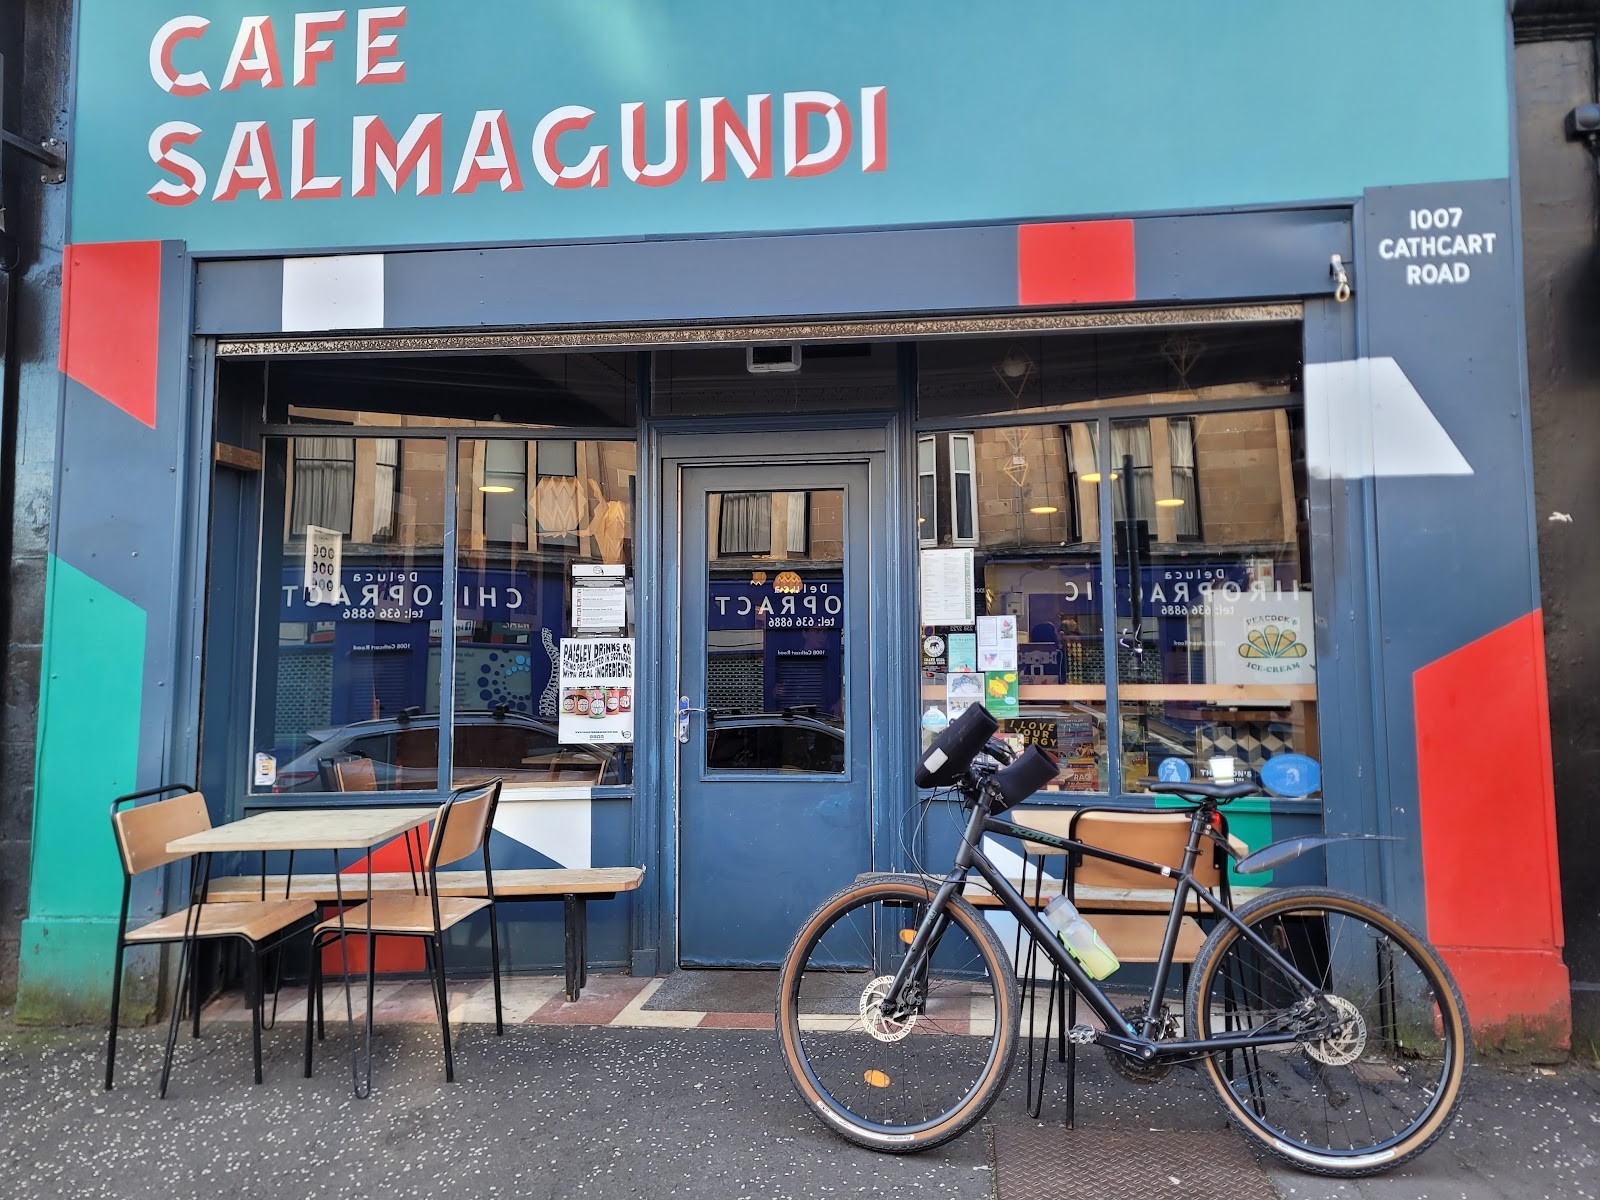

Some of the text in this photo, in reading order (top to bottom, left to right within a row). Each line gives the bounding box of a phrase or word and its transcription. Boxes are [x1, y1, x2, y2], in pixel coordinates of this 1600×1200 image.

[149, 6, 407, 97] CAFE
[146, 86, 888, 207] SALMAGUNDI
[1410, 207, 1463, 230] 1007
[1378, 233, 1497, 259] CATHCART
[1406, 262, 1471, 286] ROAD
[578, 669, 593, 678] REAL
[1009, 719, 1056, 732] I LOVE
[1014, 727, 1050, 739] YOUR
